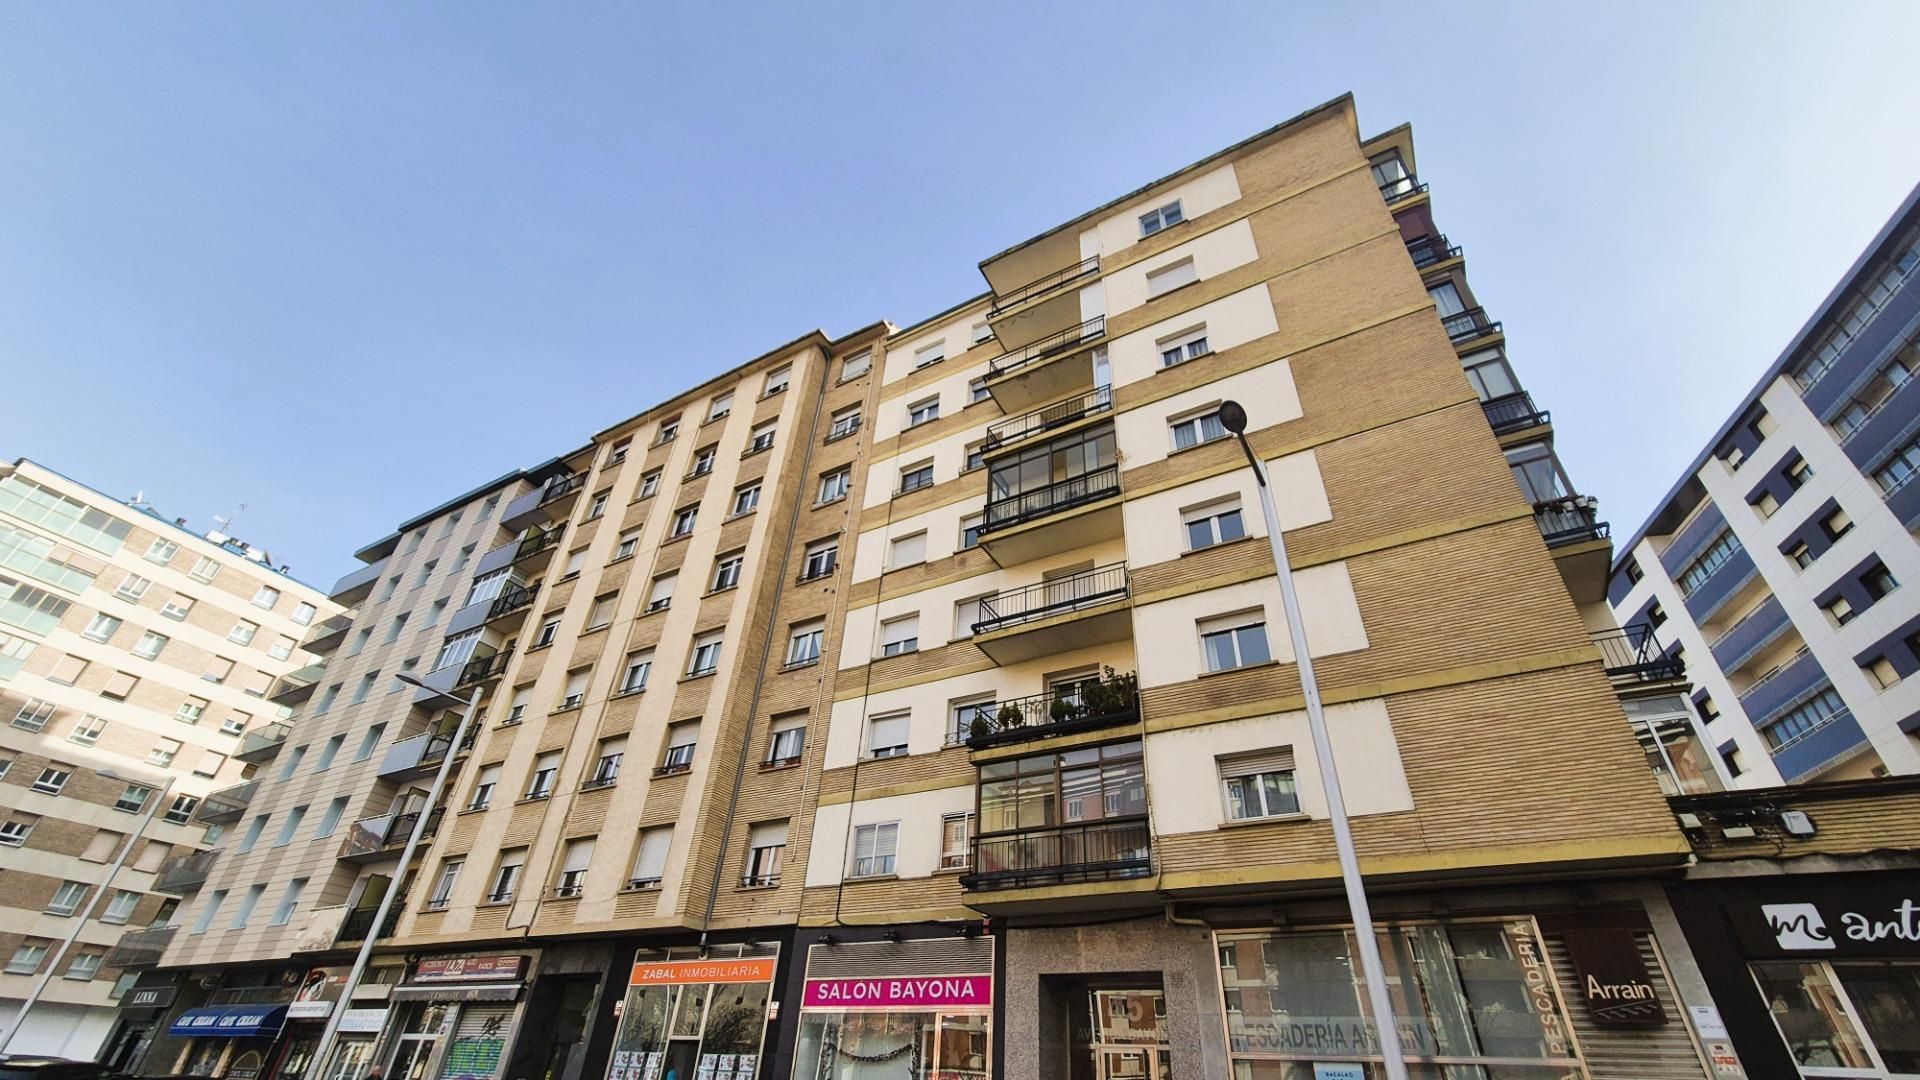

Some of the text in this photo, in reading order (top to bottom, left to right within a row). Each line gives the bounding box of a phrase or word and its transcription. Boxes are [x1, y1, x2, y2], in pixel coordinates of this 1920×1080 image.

[1841, 899, 1920, 941] ant
[642, 965, 760, 980] ZABAL INMOBILIARIA
[817, 979, 976, 1000] SALÓN BAYONA
[1587, 973, 1655, 1000] Arrain
[1232, 1017, 1427, 1050] PESCADERÍA ARIN
